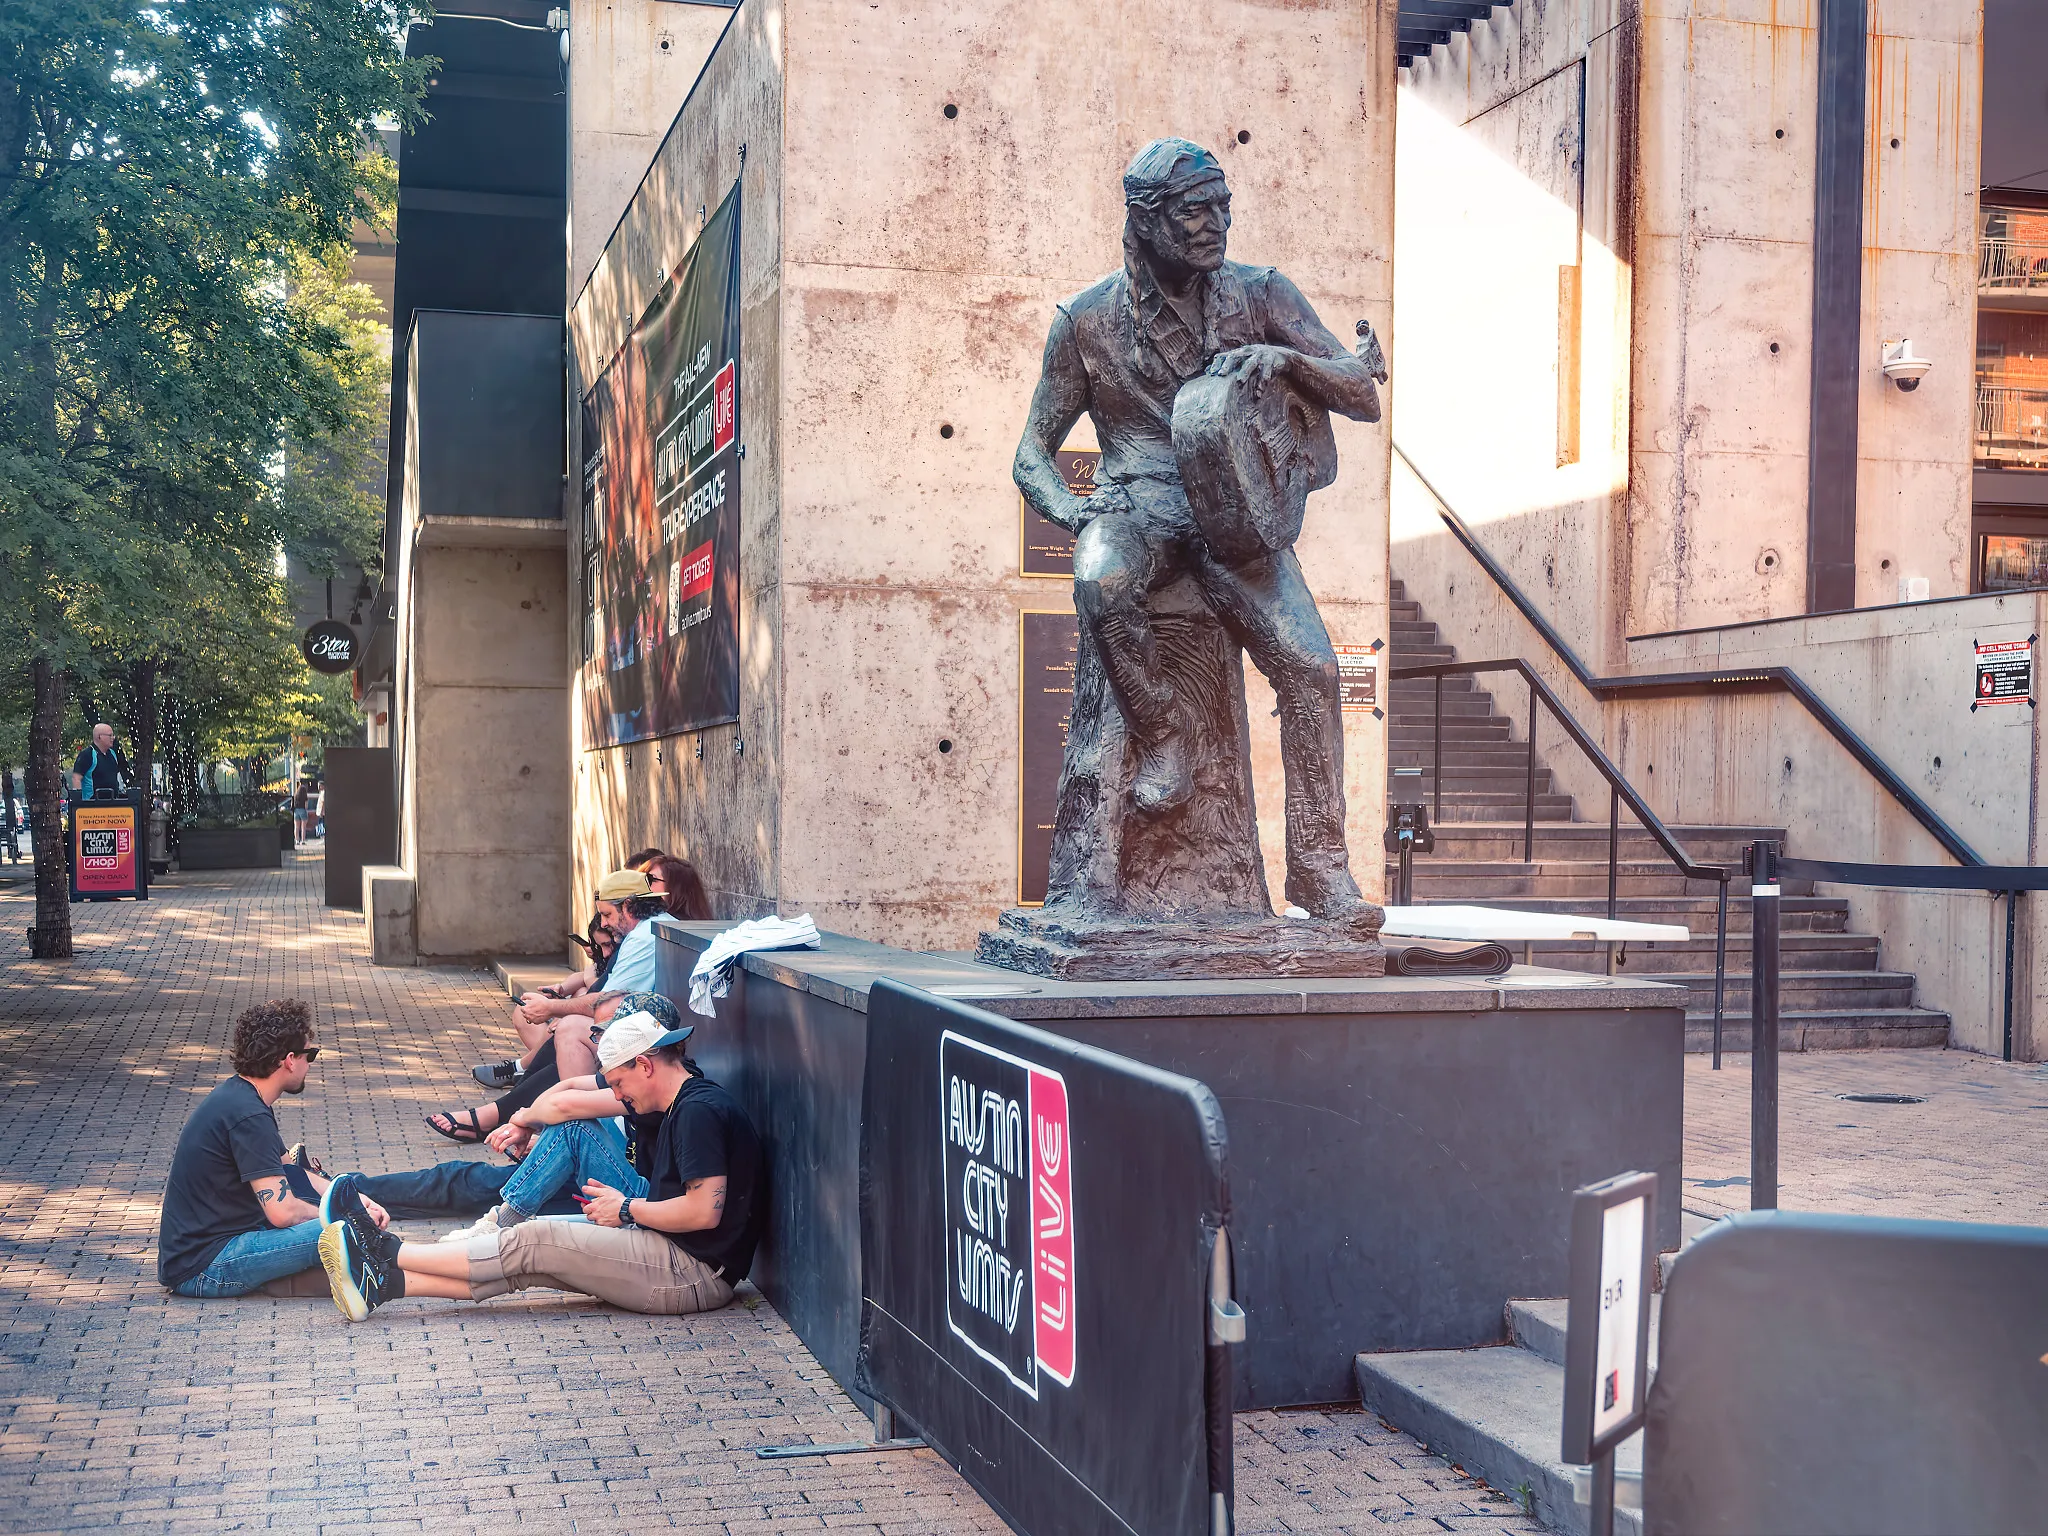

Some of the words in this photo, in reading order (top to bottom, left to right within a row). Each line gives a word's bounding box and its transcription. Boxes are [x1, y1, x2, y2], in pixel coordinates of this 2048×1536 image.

[673, 370, 685, 401] THE
[661, 507, 680, 546] TOUR
[679, 469, 726, 534] EXPERIENCE
[683, 564, 692, 587] GET
[691, 554, 711, 582] TICKETS
[311, 634, 350, 655] 3ten
[1998, 643, 2013, 651] PHONE
[2013, 642, 2028, 650] USAGE
[84, 832, 115, 840] AUSTIN
[89, 839, 109, 847] CITY
[86, 846, 114, 854] LIMITS
[86, 858, 116, 867] SHOP
[950, 1075, 1023, 1180] AUSTIN
[963, 1159, 1009, 1249] CITY
[957, 1226, 1024, 1335] LIMITS
